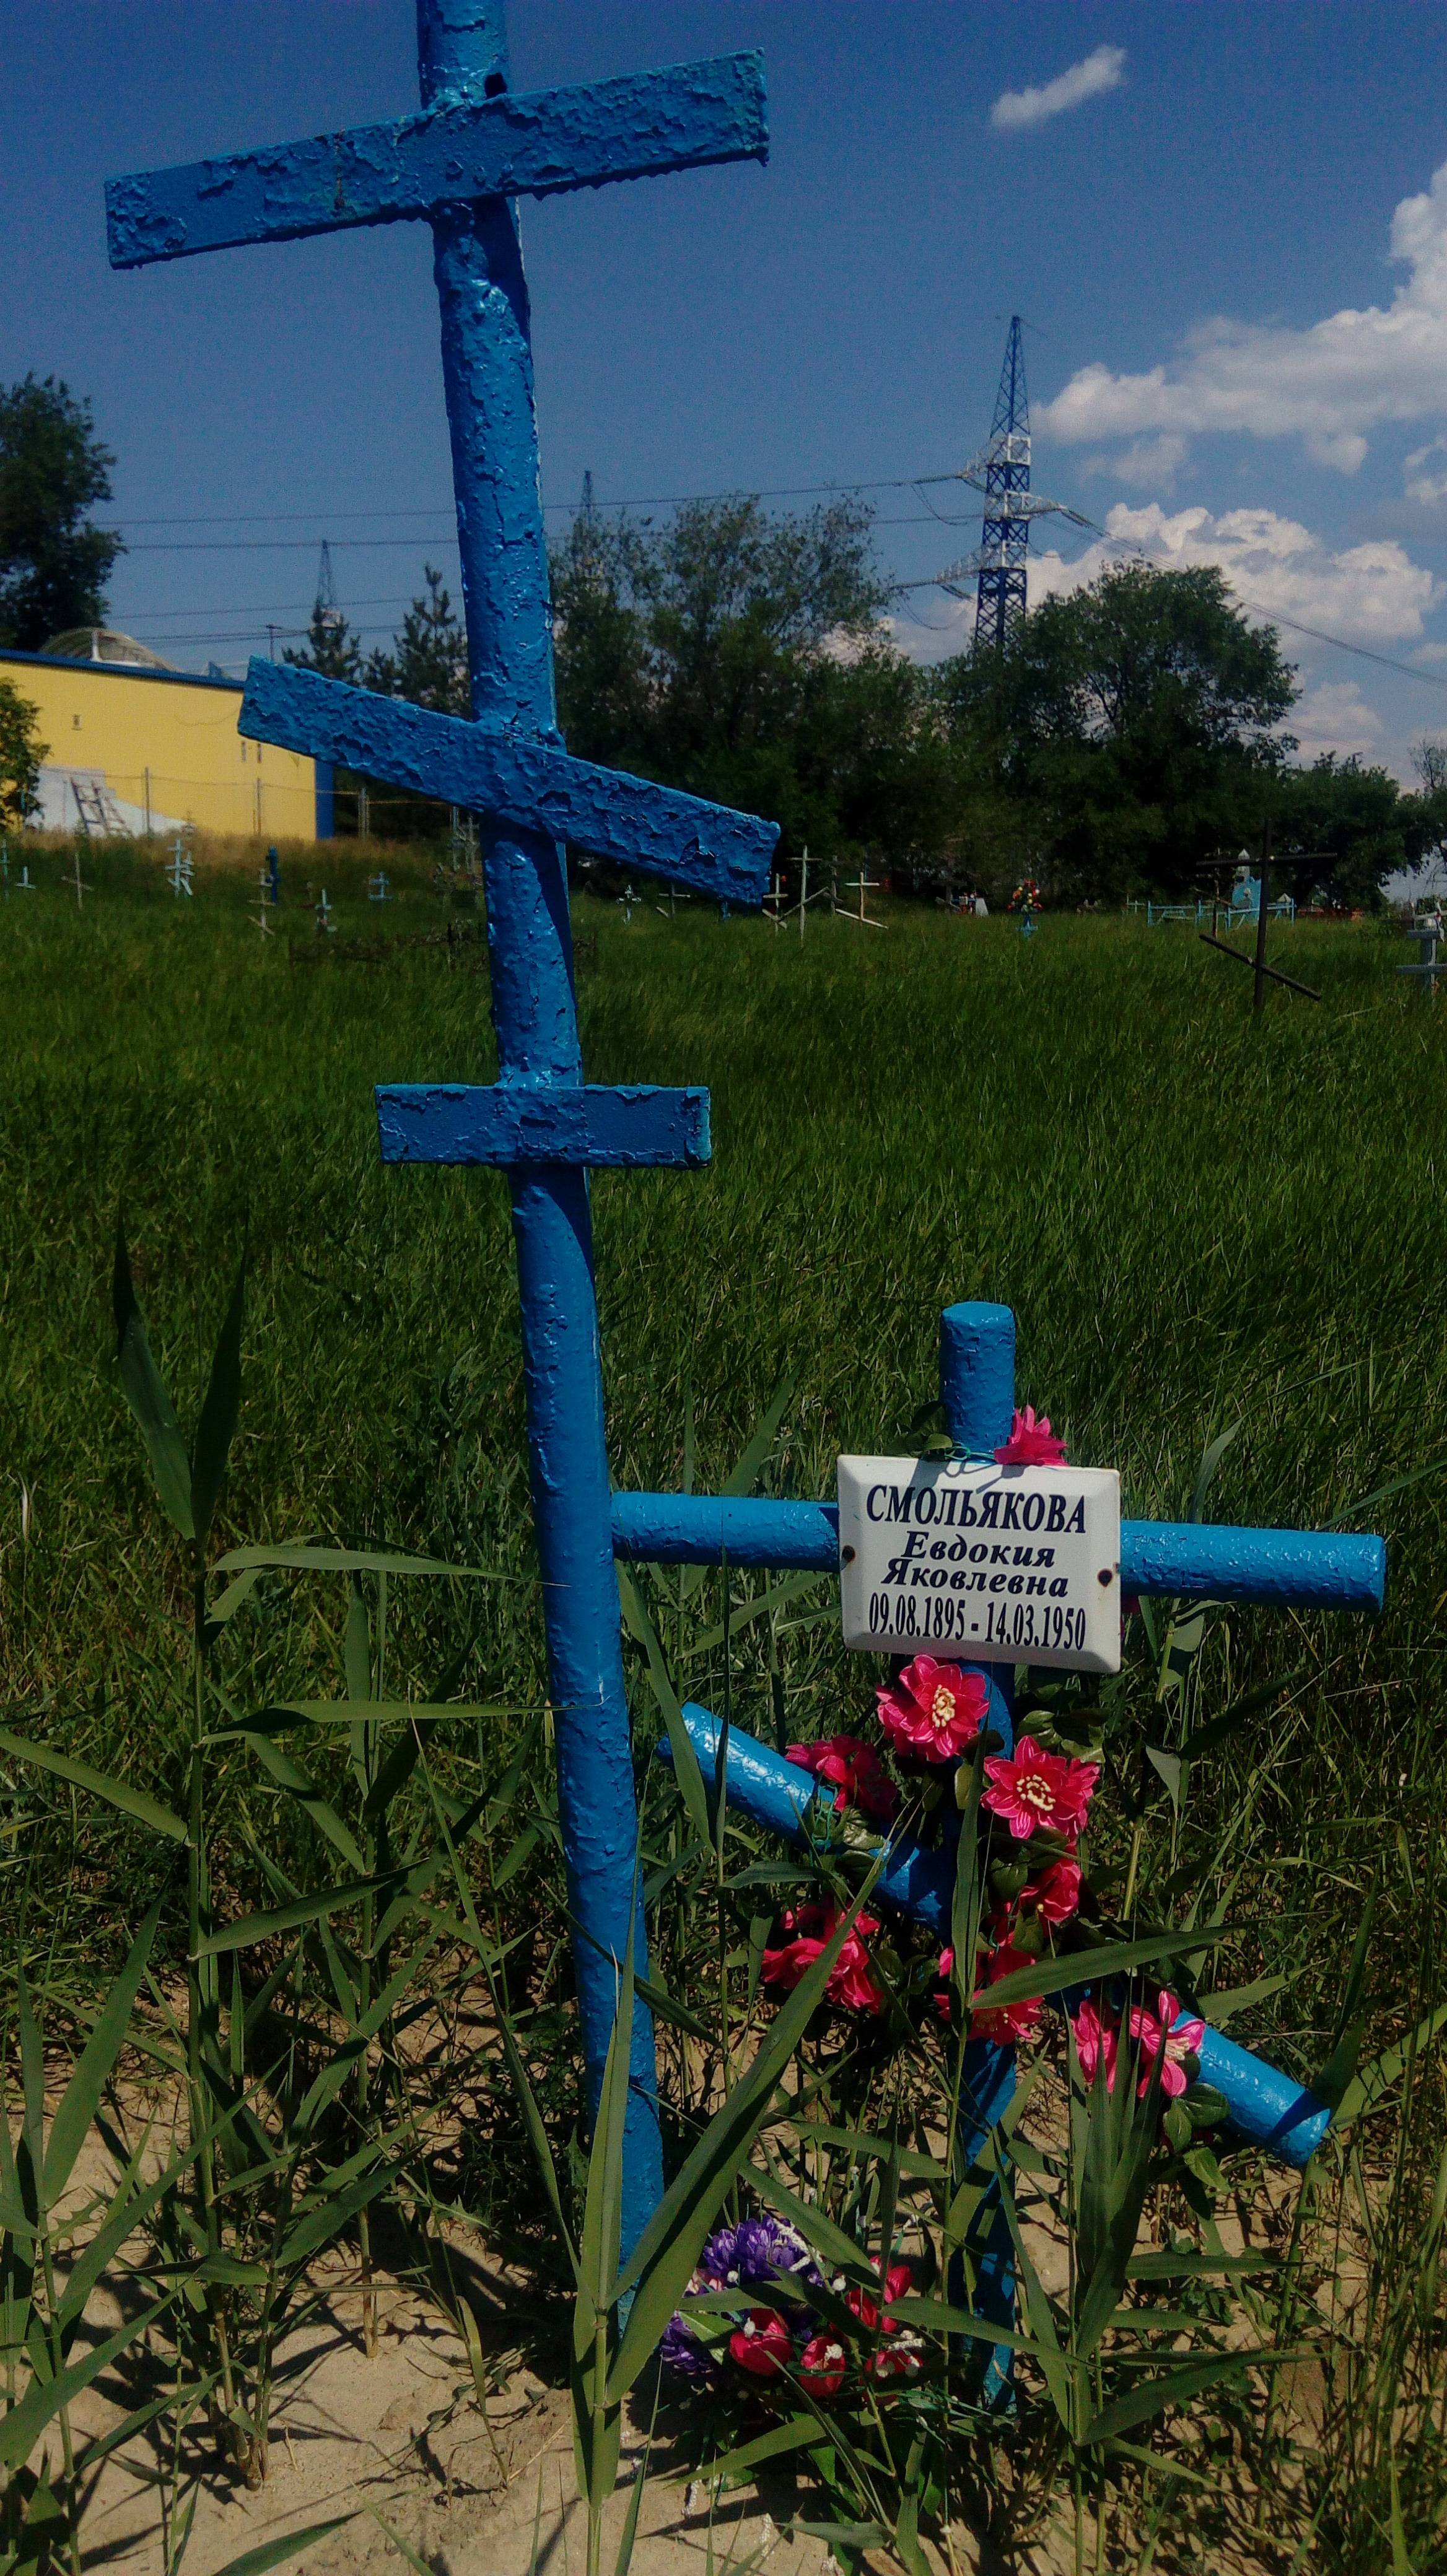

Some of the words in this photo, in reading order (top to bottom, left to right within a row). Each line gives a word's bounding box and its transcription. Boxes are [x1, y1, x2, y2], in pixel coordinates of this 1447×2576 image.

[867, 1484, 1086, 1534] СМОЛЬЯКОВА
[901, 1530, 1056, 1569] Евдокия
[880, 1557, 1069, 1598] Яковлевна
[869, 1592, 966, 1640] 09.08.1895
[984, 1601, 1086, 1651] 14.03.1950
